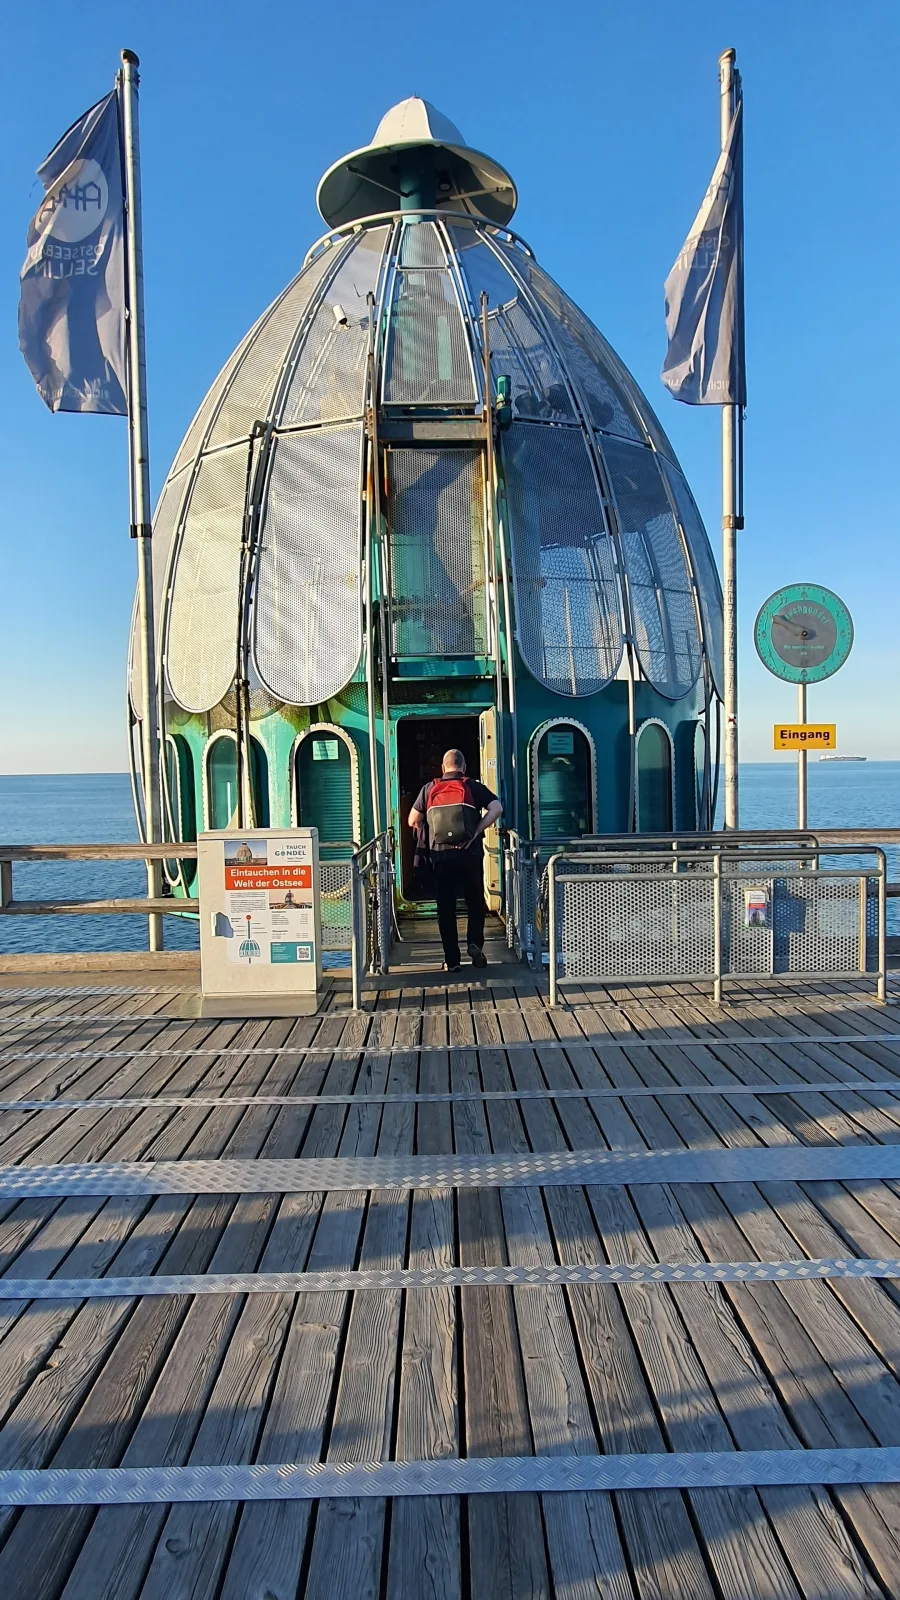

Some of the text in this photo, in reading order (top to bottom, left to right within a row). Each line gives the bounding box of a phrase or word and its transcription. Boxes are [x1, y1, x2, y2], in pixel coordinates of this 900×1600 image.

[784, 605, 830, 624] auchgondel
[780, 730, 830, 741] Eingang
[230, 867, 307, 877] Eintauchen in die
[233, 878, 303, 889] Welt der Ostsee
